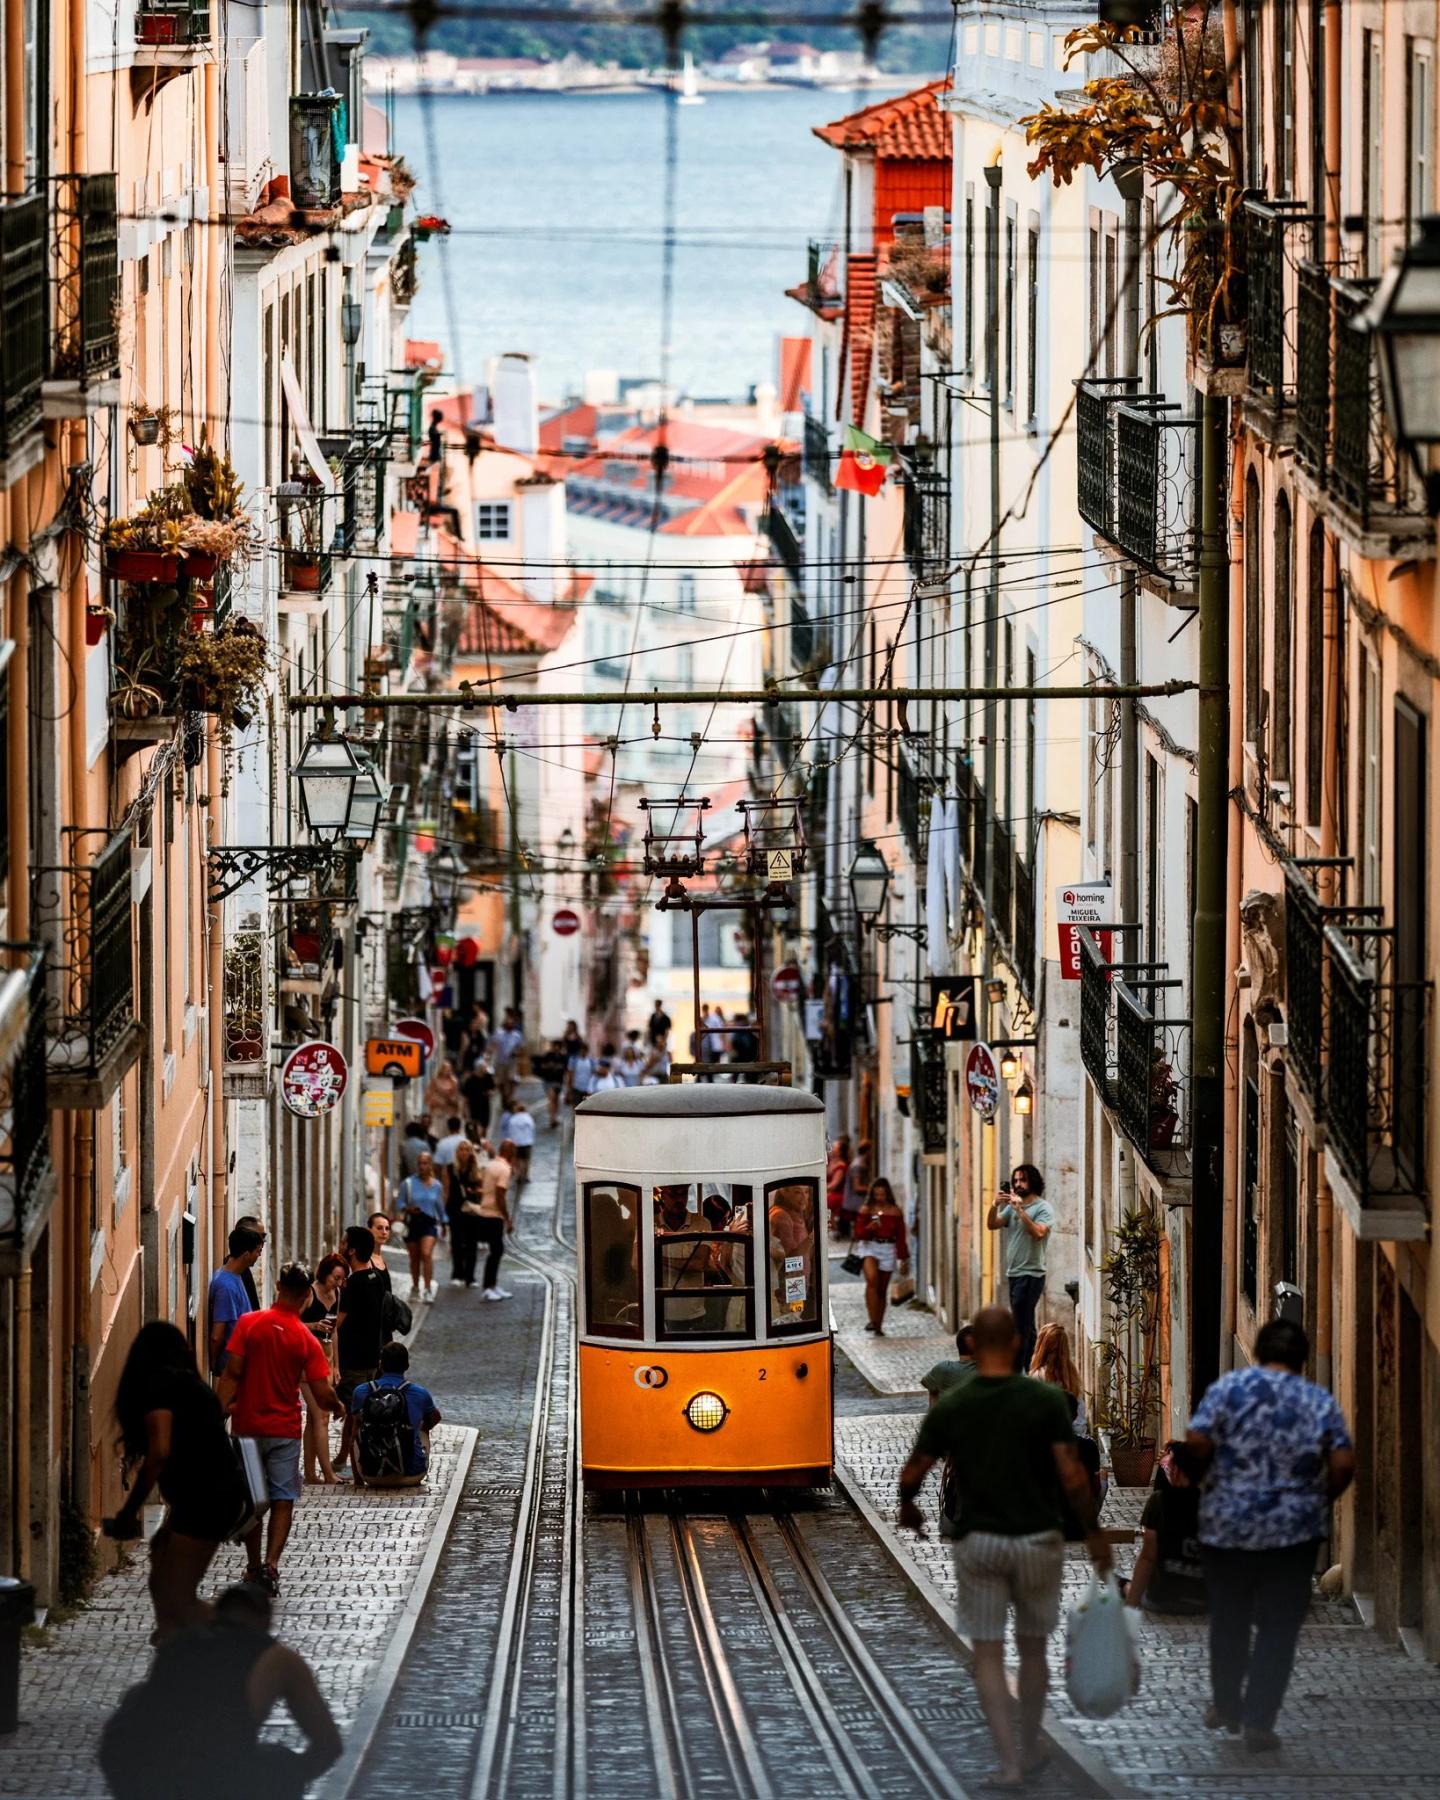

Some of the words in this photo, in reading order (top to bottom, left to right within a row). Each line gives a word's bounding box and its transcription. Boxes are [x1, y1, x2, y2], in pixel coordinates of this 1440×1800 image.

[1076, 892, 1105, 905] homing
[376, 1043, 412, 1057] ATM
[758, 1368, 767, 1381] 2
